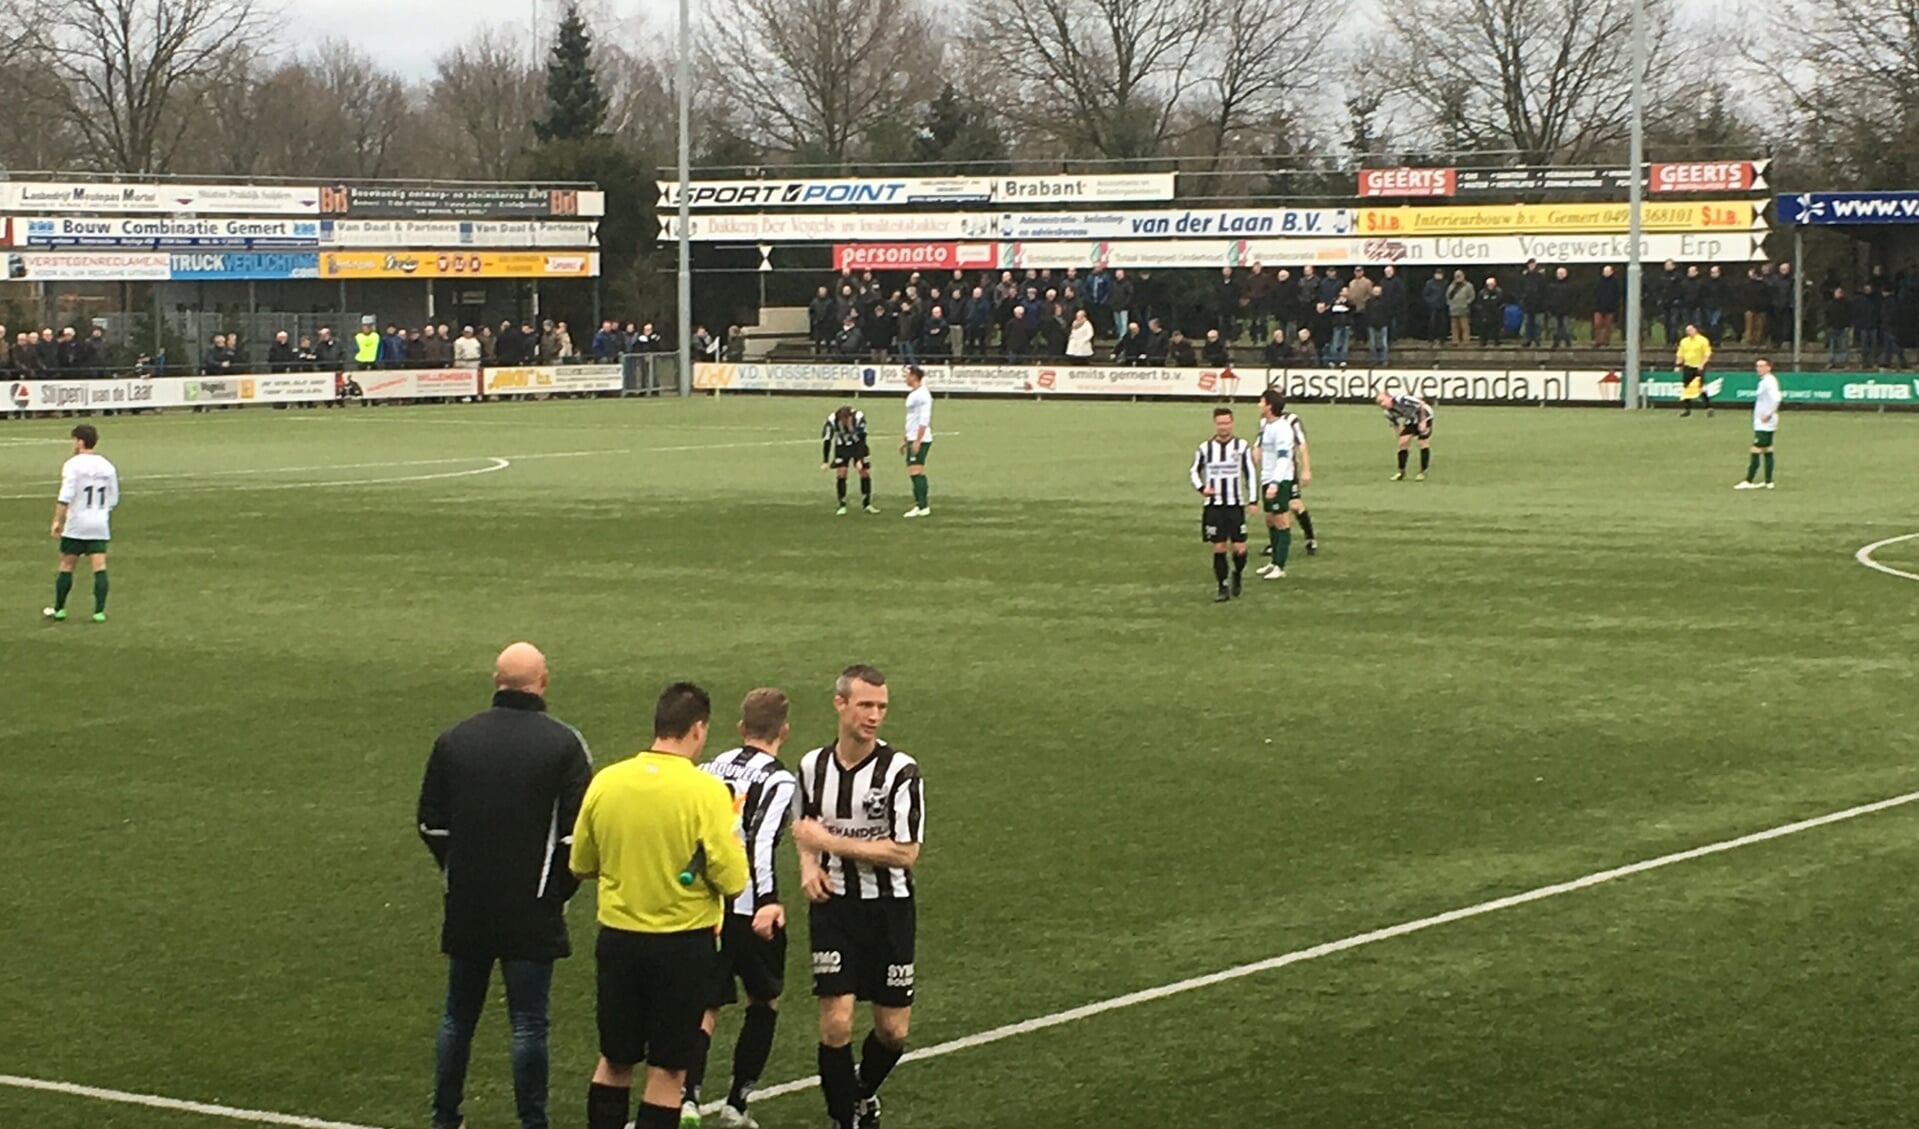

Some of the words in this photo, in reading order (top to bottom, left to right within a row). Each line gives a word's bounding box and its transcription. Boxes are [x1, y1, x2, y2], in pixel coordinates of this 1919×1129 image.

[1367, 170, 1446, 188] GEERTS
[1660, 164, 1743, 183] GEERTS
[802, 183, 906, 202] POINT
[1005, 180, 1083, 197] Brabant
[1831, 199, 1919, 218] www.v
[63, 219, 112, 234] Bouw
[122, 219, 219, 235] Combinatie
[226, 221, 287, 235] Gemert
[337, 222, 360, 232] Van
[406, 222, 457, 233] Partners
[475, 223, 497, 233] Van
[1131, 215, 1169, 234] van
[1175, 212, 1212, 233] der
[1218, 212, 1273, 233] Laan
[1281, 211, 1322, 232] B.V.
[1414, 213, 1511, 228] Interieurbouw
[1548, 210, 1600, 225] Gemert
[1434, 238, 1490, 258] Uden
[1680, 234, 1722, 258] Erp
[841, 244, 948, 268] personato
[766, 366, 861, 380] VOSSENBERG
[1068, 369, 1105, 380] smits
[1109, 369, 1157, 382] gemert
[127, 382, 153, 401] Laar
[1266, 368, 1571, 401] klassiekeveranda.nl
[1639, 378, 1684, 398] rima
[1843, 379, 1912, 399] erima
[83, 485, 107, 510] 11
